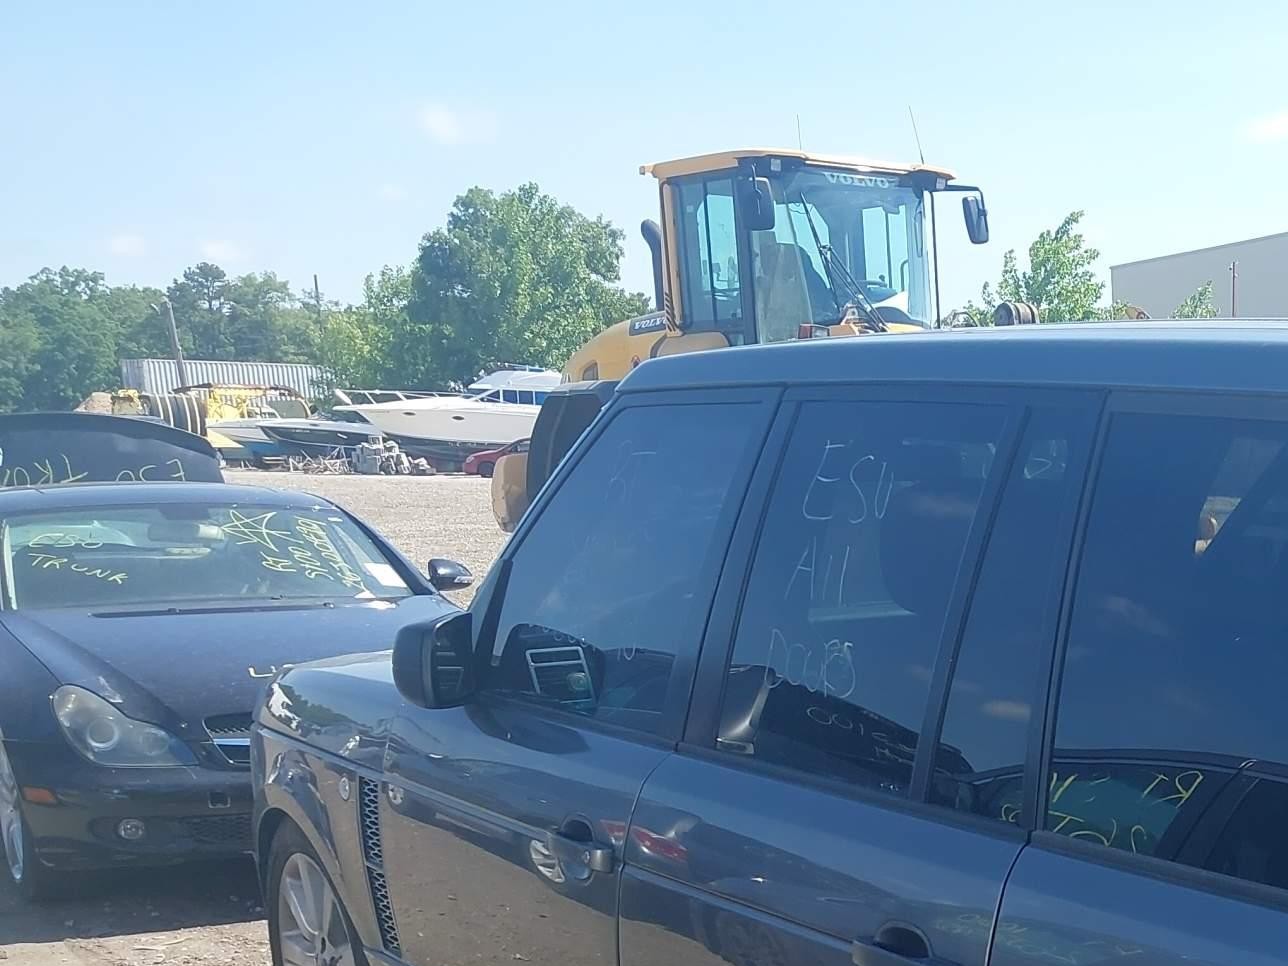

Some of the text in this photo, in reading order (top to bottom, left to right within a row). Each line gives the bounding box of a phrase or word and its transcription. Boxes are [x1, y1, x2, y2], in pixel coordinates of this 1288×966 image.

[822, 172, 890, 188] VOLVO
[802, 440, 895, 524] ESU
[27, 552, 129, 585] TRUNK
